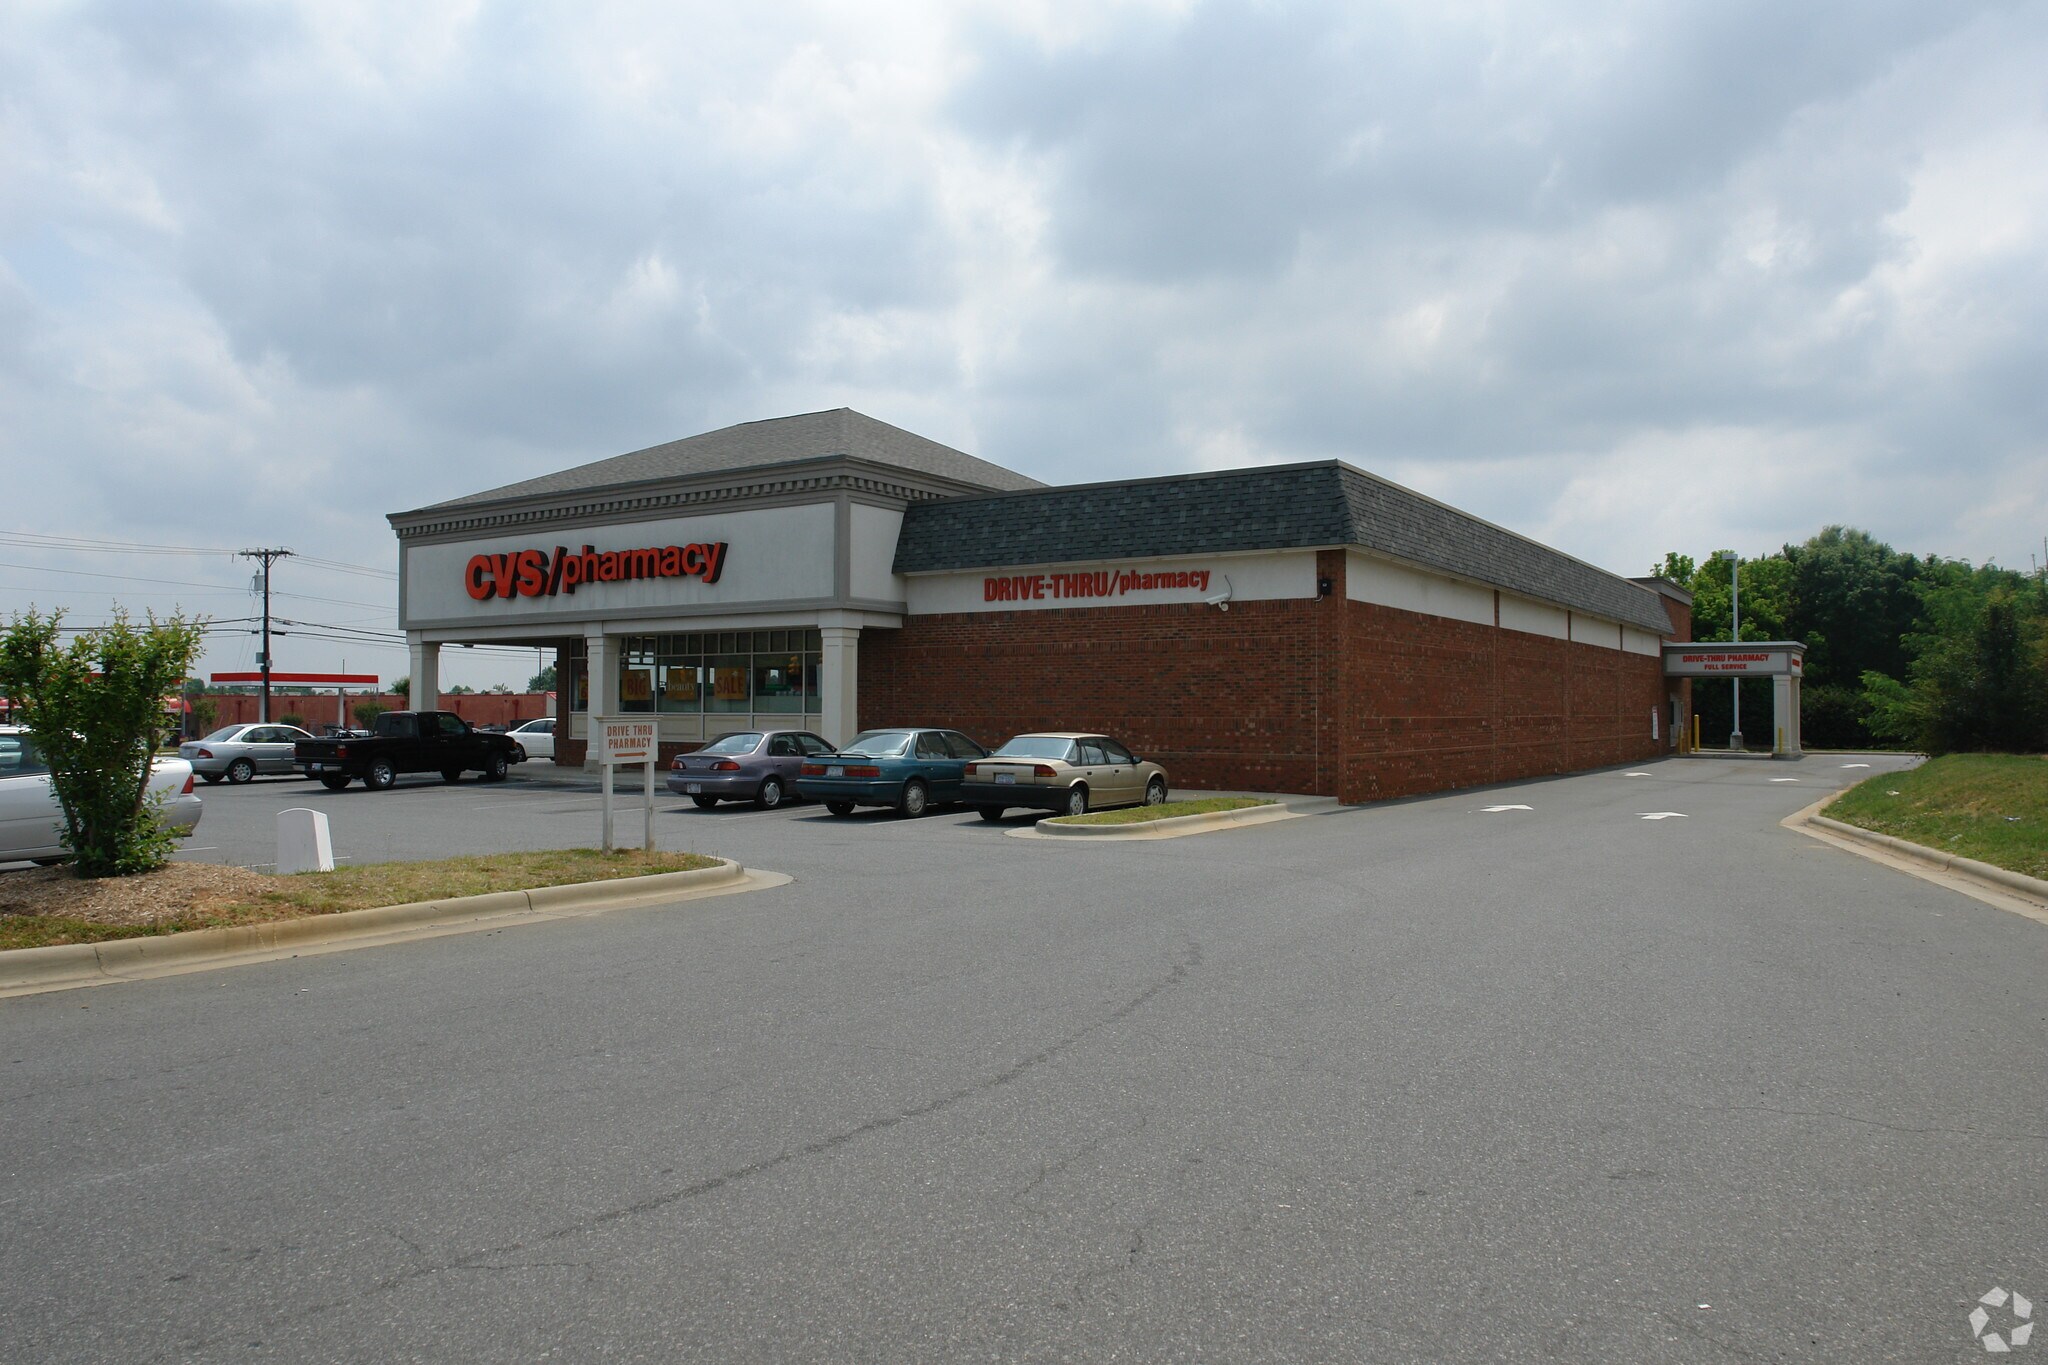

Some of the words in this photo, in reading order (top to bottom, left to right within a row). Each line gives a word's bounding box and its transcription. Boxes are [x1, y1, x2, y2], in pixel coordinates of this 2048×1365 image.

[465, 542, 728, 600] CVS/pharmacy
[984, 570, 1210, 602] DRIVE-THRU/pharmacy
[1682, 654, 1726, 663] DRIVE-THRU
[1727, 653, 1770, 662] PHARMACY
[627, 678, 647, 696] BIG
[716, 675, 744, 694] SALE
[607, 725, 630, 737] DRIVE
[633, 725, 653, 736] THRU
[608, 737, 652, 749] PHARMACY
